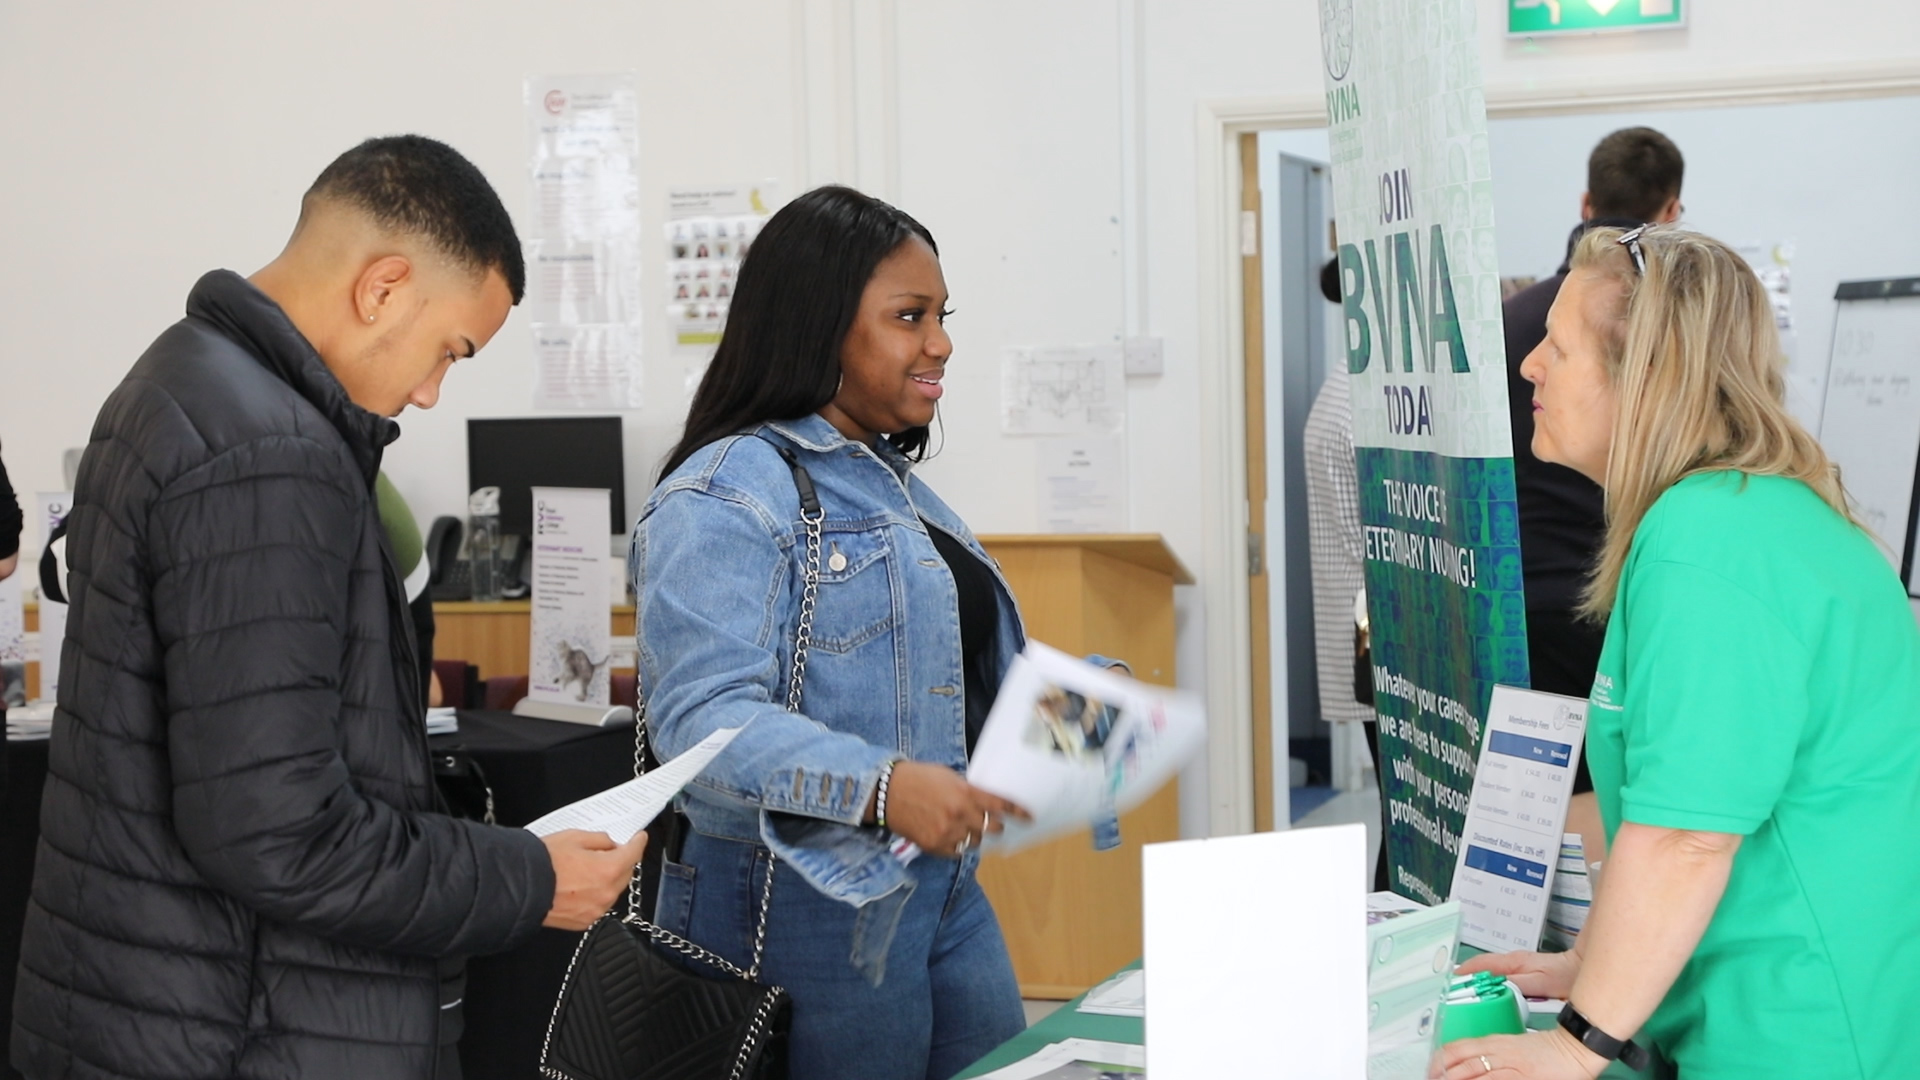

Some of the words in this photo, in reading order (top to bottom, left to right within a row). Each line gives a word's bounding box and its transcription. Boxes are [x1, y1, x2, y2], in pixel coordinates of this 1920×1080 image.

[1338, 224, 1471, 374] BVNA
[1401, 481, 1441, 523] VOICE
[1378, 713, 1397, 737] we
[1430, 731, 1440, 759] to
[1507, 715, 1538, 728] Membership
[1538, 721, 1549, 730] Fees
[1532, 746, 1543, 754] New
[1550, 749, 1567, 759] Renewal
[1390, 797, 1442, 846] professional
[1472, 832, 1498, 845] Discounted
[1499, 839, 1512, 849] Rates
